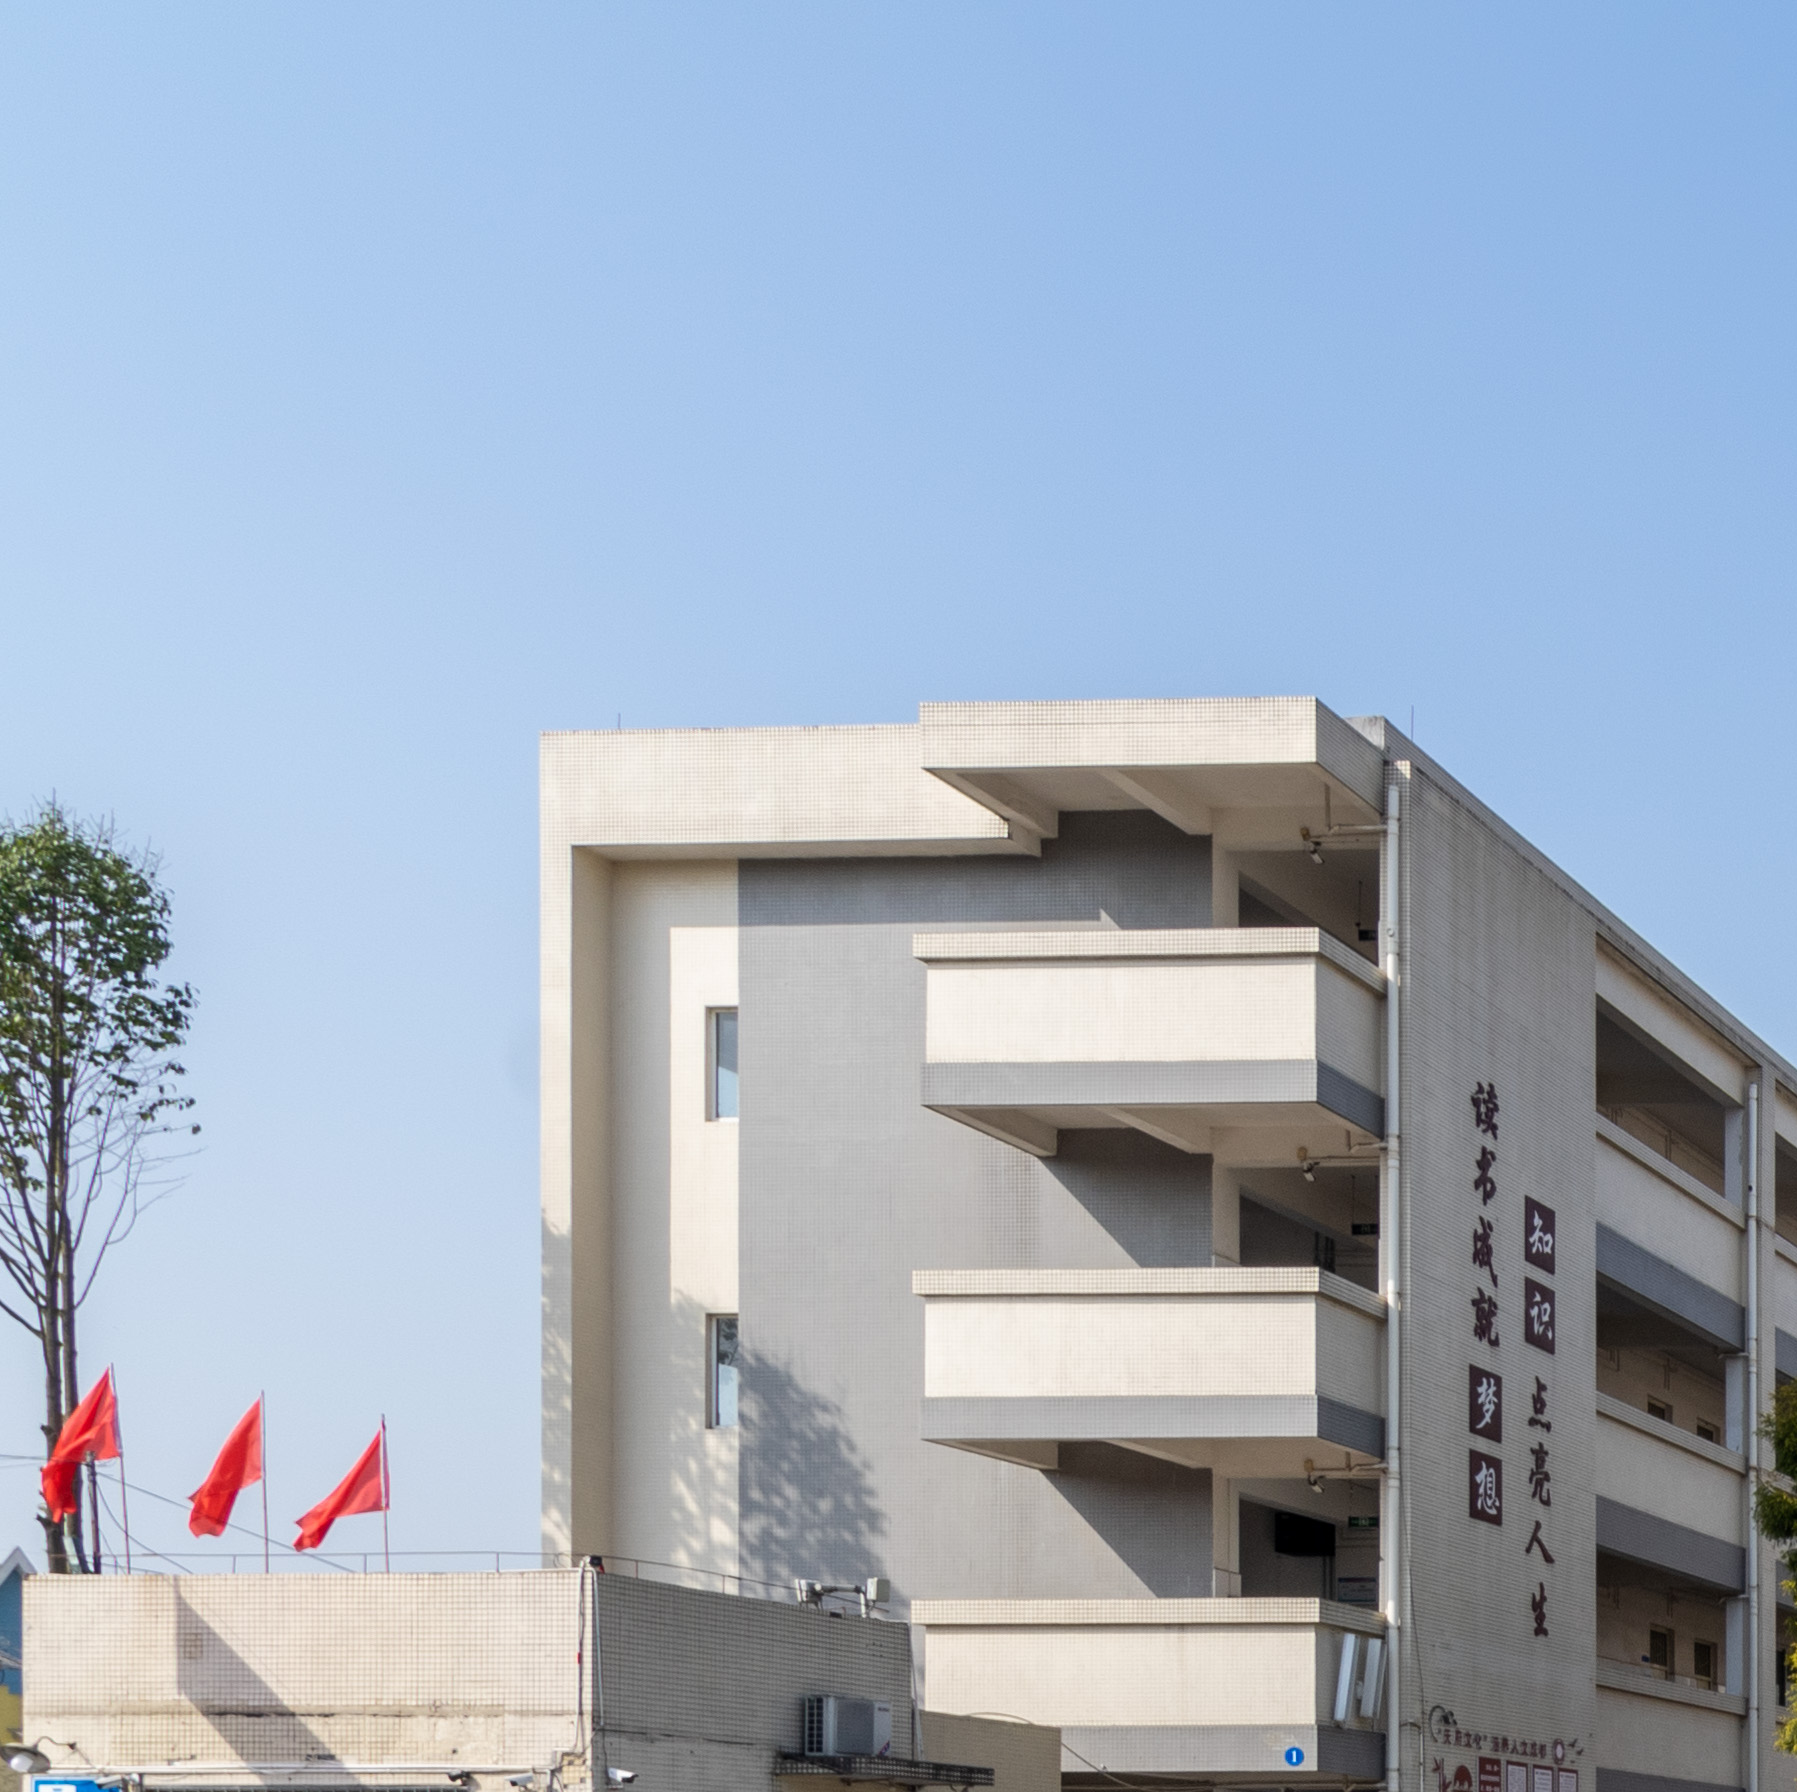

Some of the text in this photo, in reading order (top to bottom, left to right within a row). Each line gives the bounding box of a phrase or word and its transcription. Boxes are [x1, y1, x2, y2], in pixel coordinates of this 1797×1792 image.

[1469, 1080, 1503, 1518] 读书成就梦想
[1524, 1207, 1557, 1640] 知识点亮人生
